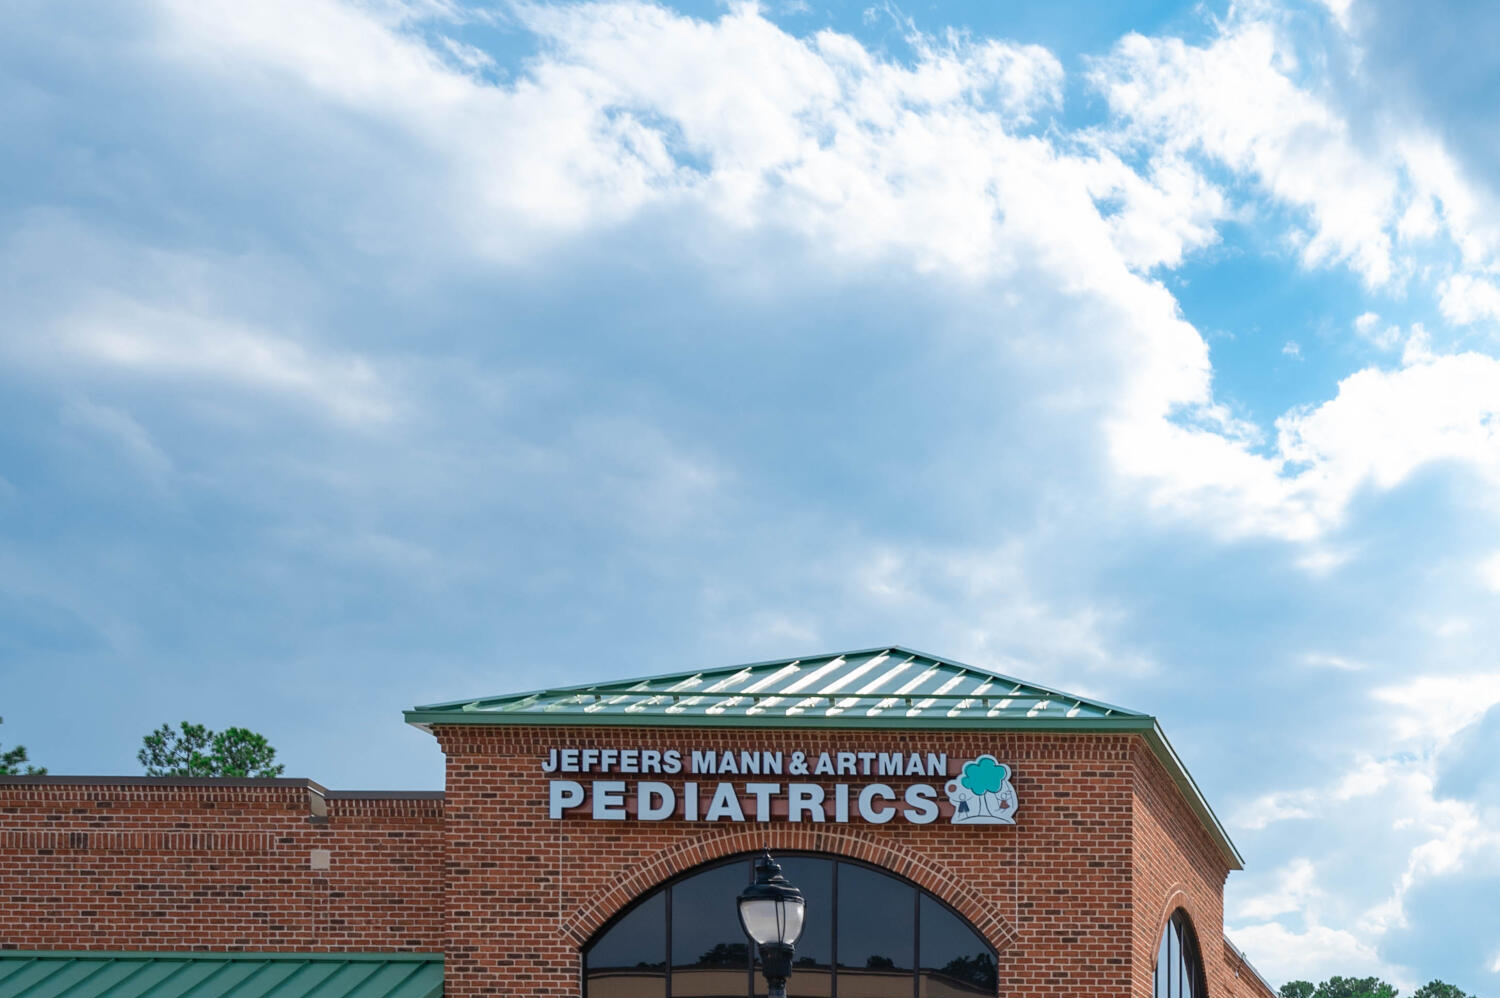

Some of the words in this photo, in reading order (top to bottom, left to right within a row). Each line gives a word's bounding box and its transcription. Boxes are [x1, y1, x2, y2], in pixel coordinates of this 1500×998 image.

[541, 749, 682, 774] JEFFERS
[691, 750, 783, 775] MANN
[788, 751, 810, 776] &
[814, 752, 947, 777] ARTMAN
[549, 780, 940, 825] PEDIATRICS
